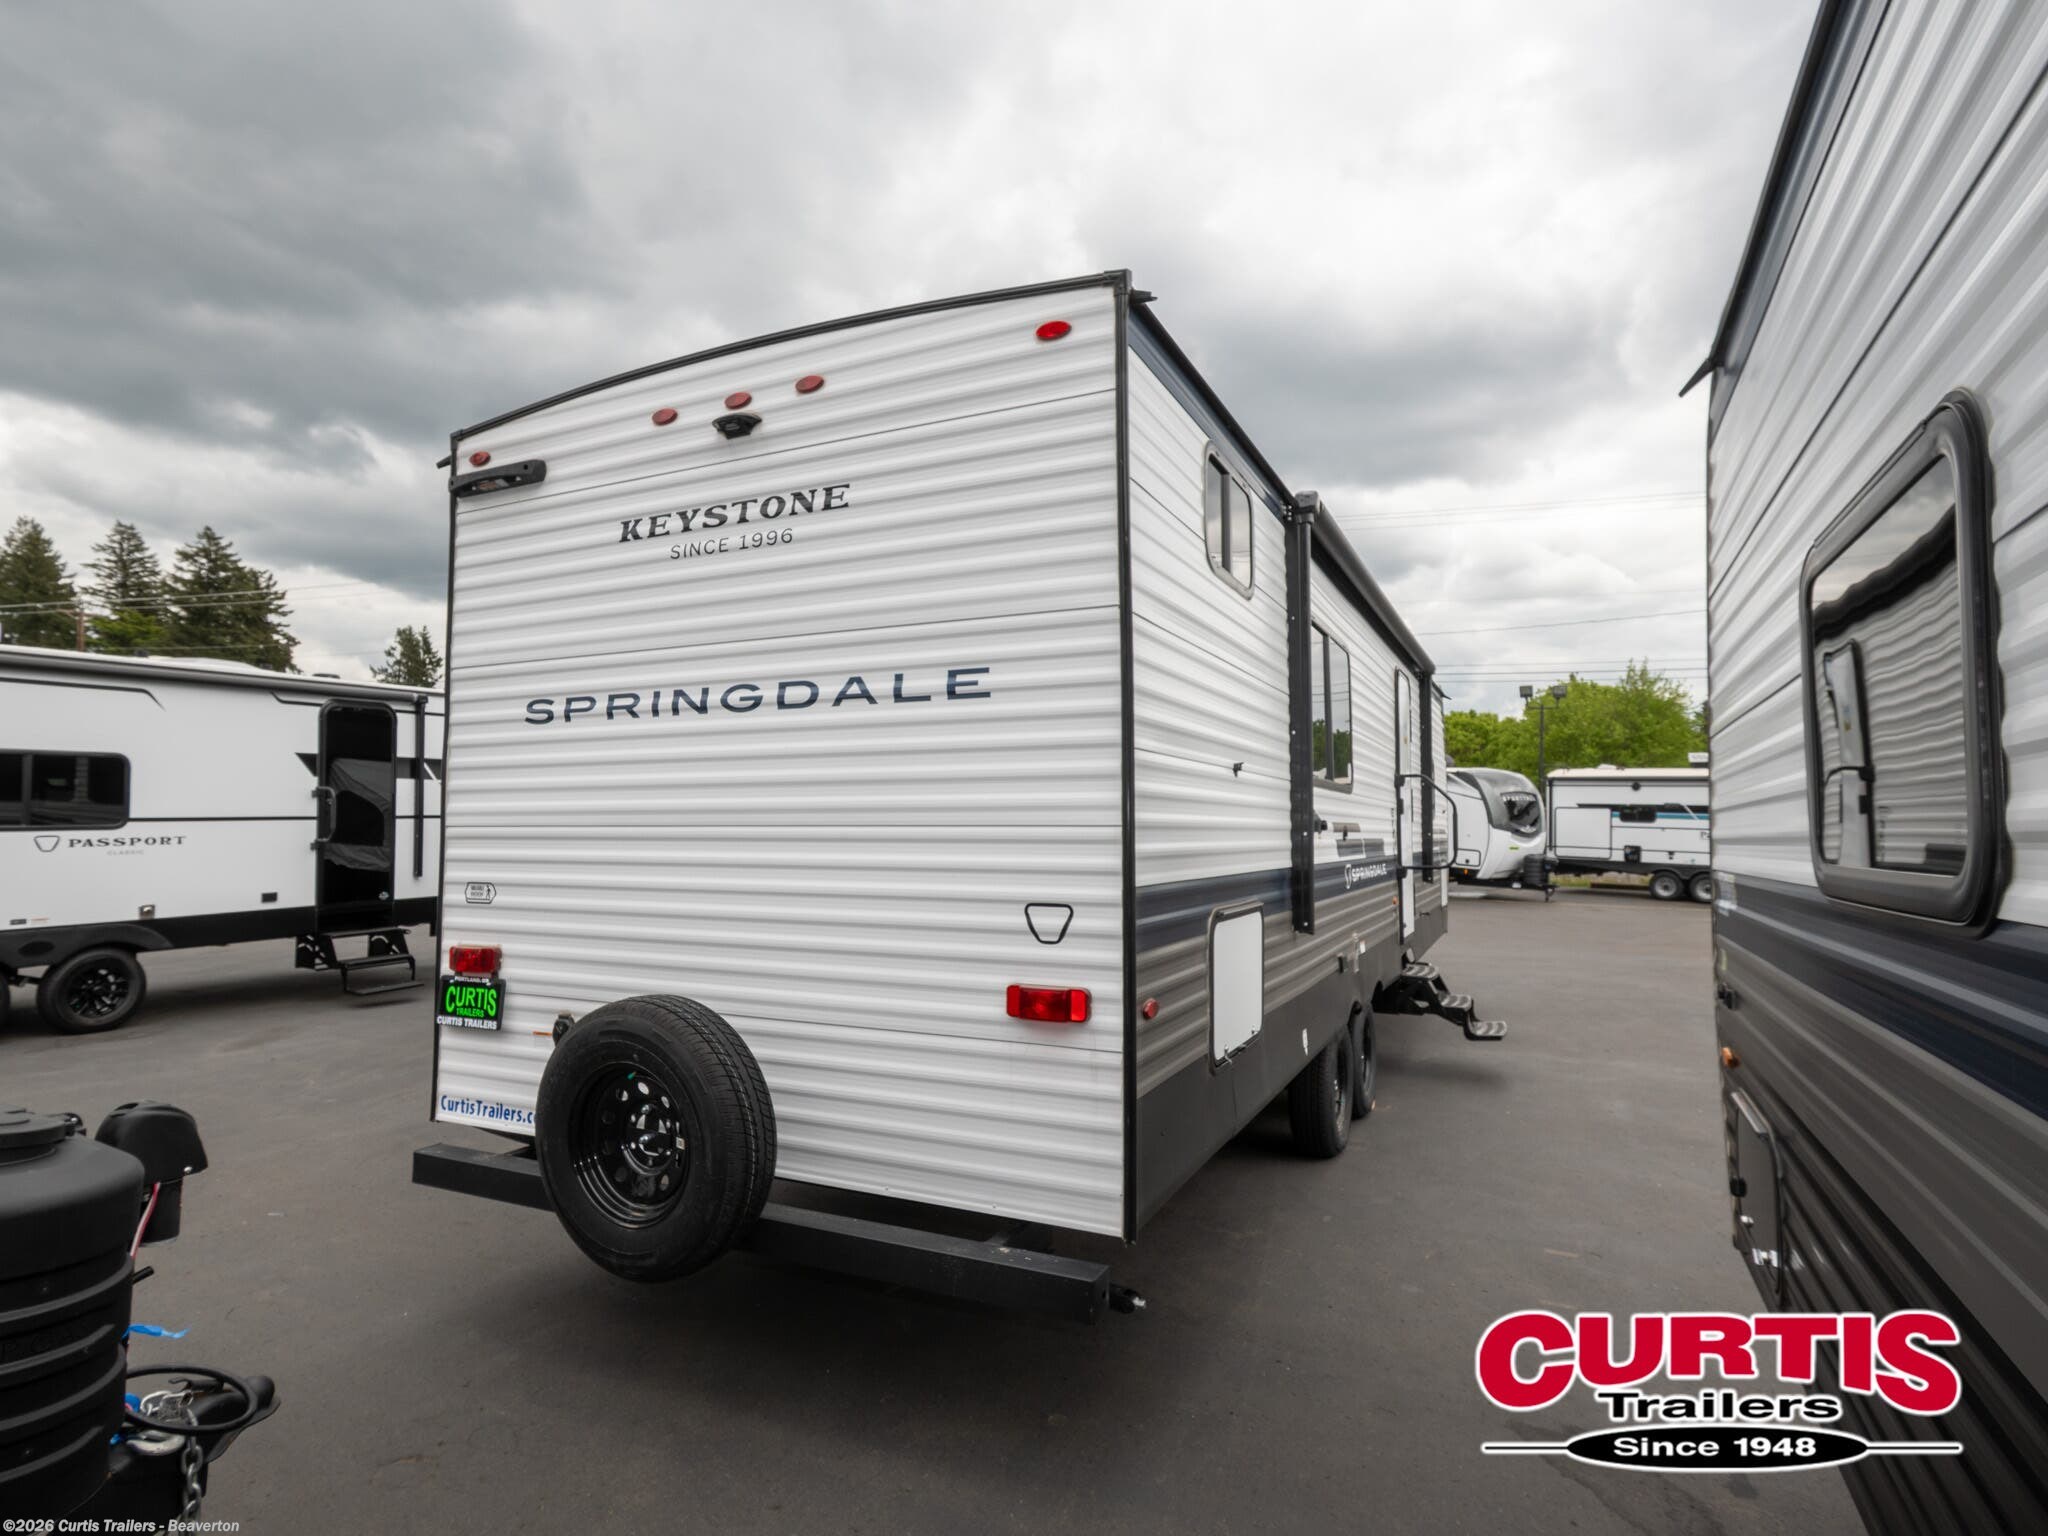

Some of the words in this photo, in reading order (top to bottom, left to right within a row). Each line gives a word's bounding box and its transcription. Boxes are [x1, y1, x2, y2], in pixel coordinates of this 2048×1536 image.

[619, 483, 850, 543] KEYSTONE
[670, 537, 729, 560] SINCE
[739, 528, 793, 550] 1996
[524, 667, 991, 725] SPRINGDALE
[68, 836, 187, 848] PASSPORT
[445, 985, 497, 1017] CURTIS
[456, 1007, 485, 1018] TRAILERS
[436, 1015, 463, 1027] CURTIS
[464, 1018, 498, 1030] TRAILERS
[440, 1095, 534, 1124] CurtisTrailers.c
